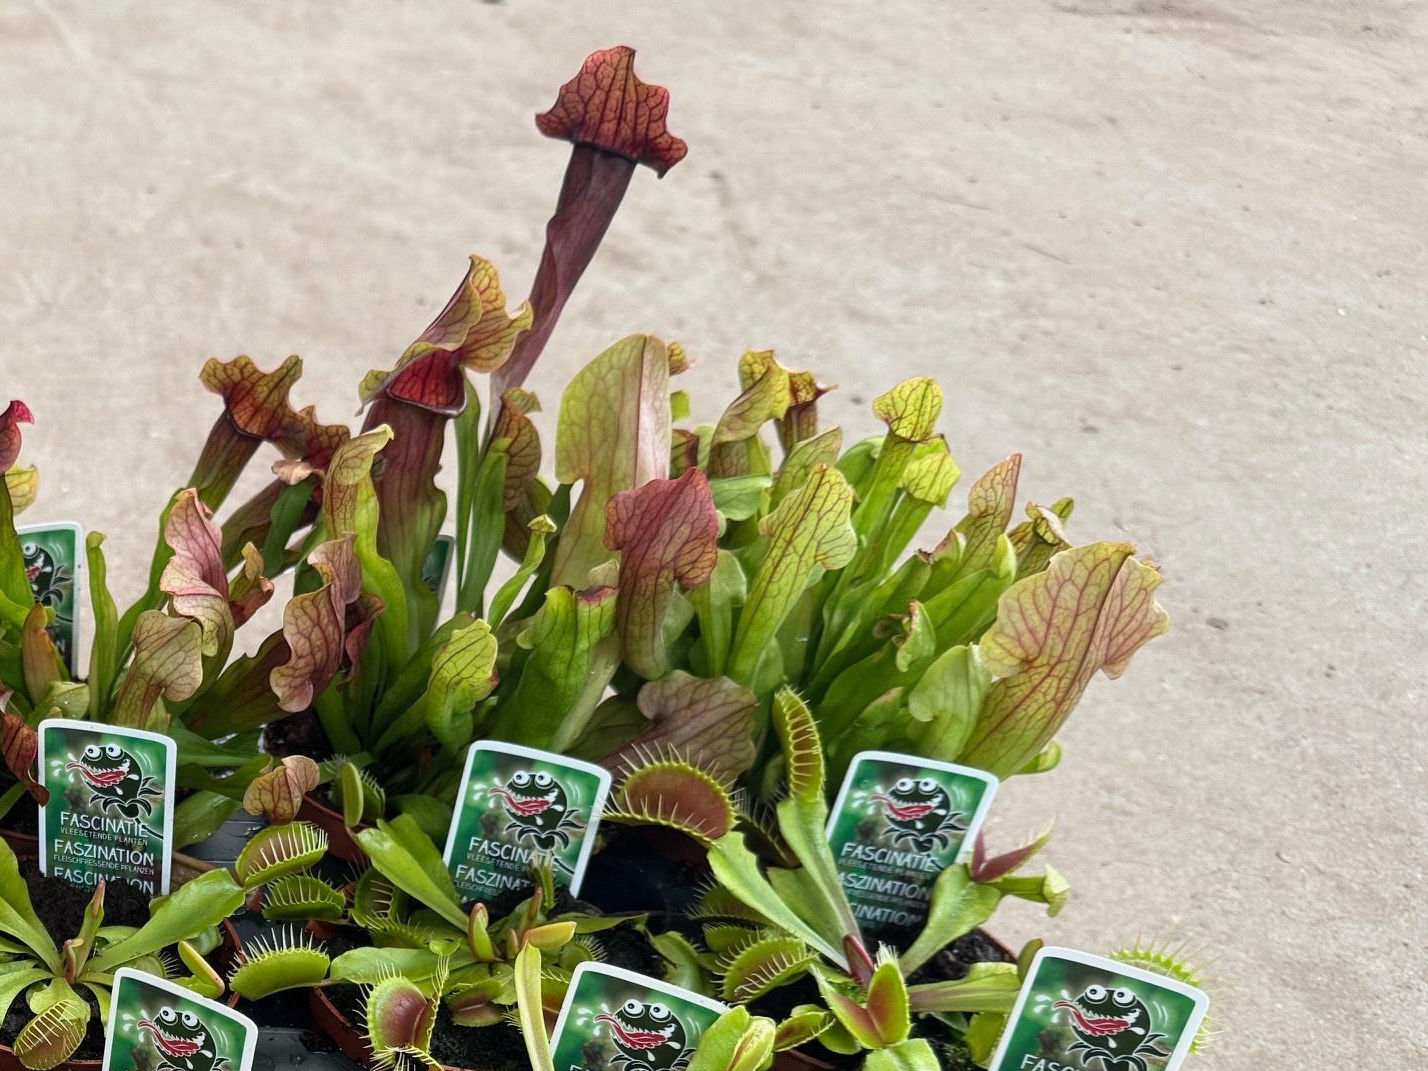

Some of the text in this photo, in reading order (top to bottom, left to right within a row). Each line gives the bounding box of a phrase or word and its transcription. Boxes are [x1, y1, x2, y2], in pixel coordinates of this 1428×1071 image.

[60, 811, 148, 837] FASCINATIE
[60, 827, 148, 845] VLEESETENDE PLANTEN
[54, 839, 154, 866] FASZINATION
[841, 842, 942, 872] FASCINATIE
[54, 868, 153, 894] FASCINION
[839, 873, 932, 901] ASZINATION
